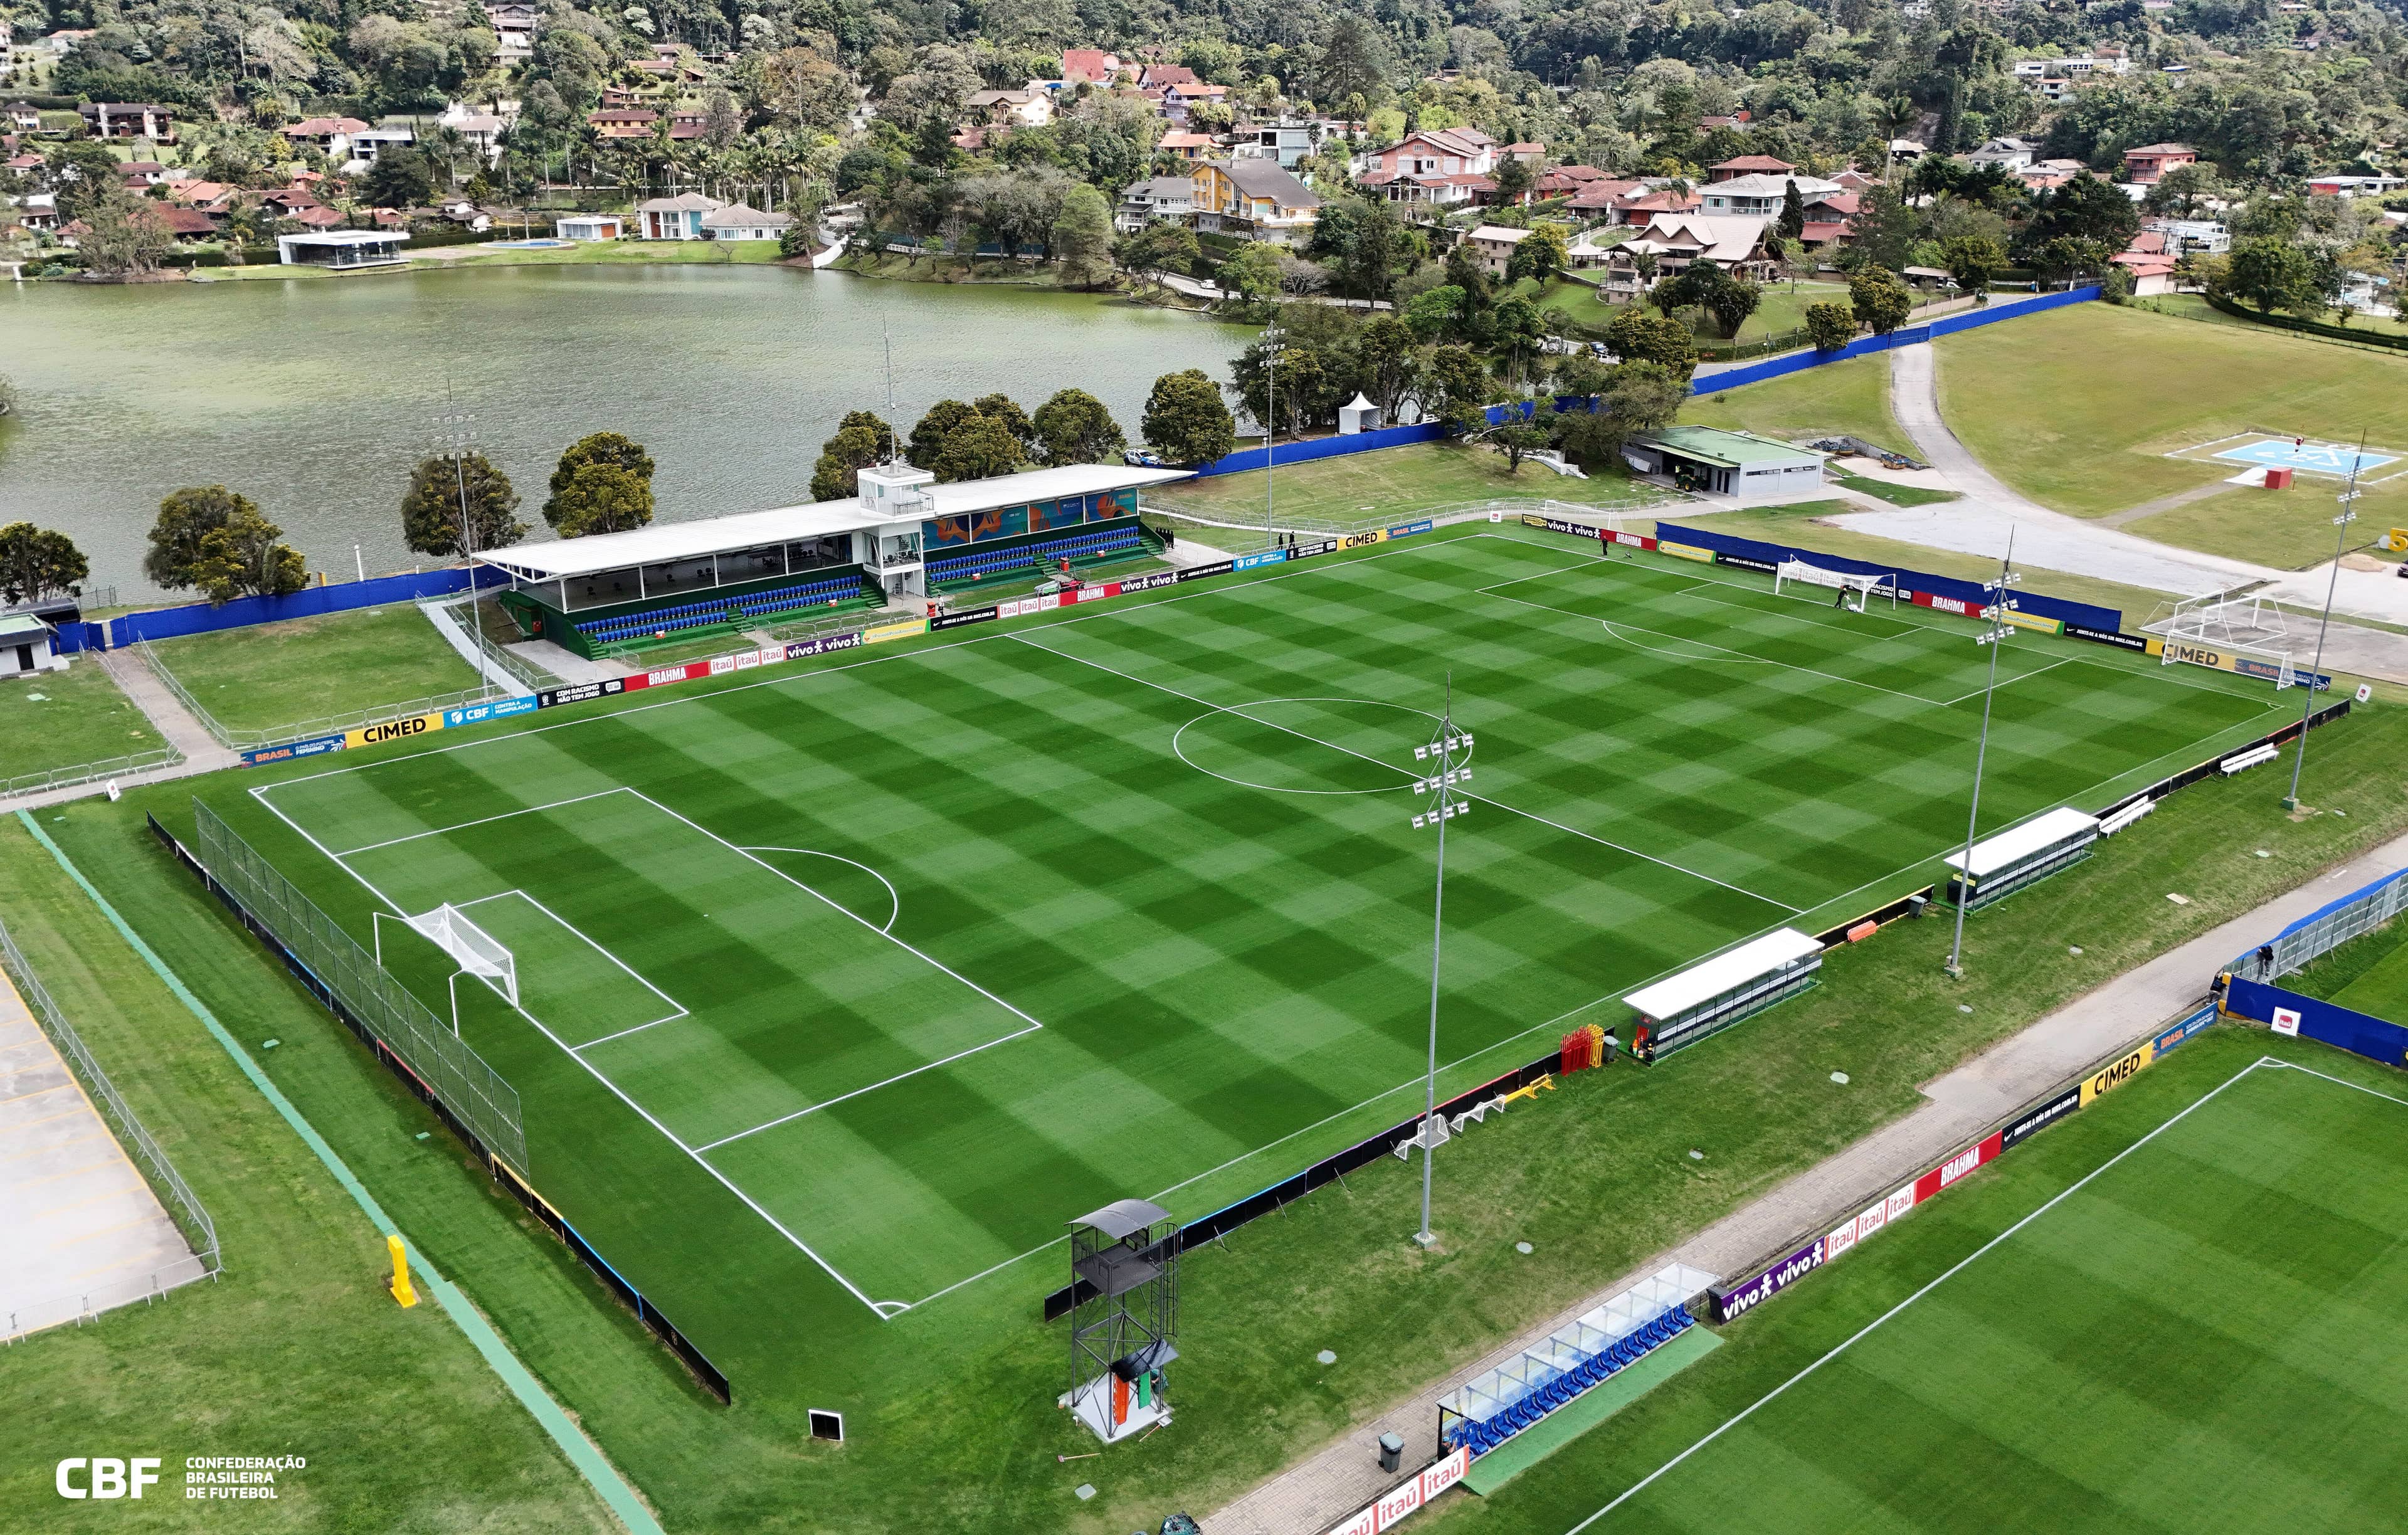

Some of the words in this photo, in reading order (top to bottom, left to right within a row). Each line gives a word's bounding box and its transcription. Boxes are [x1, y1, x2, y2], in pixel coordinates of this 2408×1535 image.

[1393, 527, 1410, 535] BRASIL
[1548, 521, 1566, 531] vivo
[1575, 525, 1593, 536] vivo
[1346, 532, 1378, 547] CIMED
[1616, 533, 1642, 547] BRAHMA
[1245, 557, 1259, 566] CBF
[1121, 581, 1141, 592] vivo
[1151, 576, 1170, 587] vivo
[1874, 583, 1894, 592] ACISMO
[1077, 586, 1104, 602] BRAHMA
[1022, 601, 1037, 612] itaú
[1042, 597, 1057, 608] itaú
[1931, 596, 1965, 614] BRAHMA
[1001, 606, 1017, 616] itaú
[788, 646, 813, 658] vivo
[826, 638, 851, 650] vivo
[2161, 643, 2219, 666] CIMED
[737, 655, 758, 666] itaú
[763, 650, 783, 662] itaú
[712, 660, 732, 670] itaú
[648, 667, 687, 686] BRAHMA
[556, 688, 573, 697] COM
[573, 684, 599, 695] RACISMO
[557, 693, 571, 704] NÃO
[571, 692, 584, 701] TEM
[584, 690, 599, 700] JOGO
[466, 707, 489, 720] CBF
[495, 702, 532, 715] MANIPULAÇÃO
[364, 717, 426, 743] CIMED
[255, 749, 293, 762] BRASIL
[295, 746, 325, 756] FEMININO
[2160, 1028, 2185, 1050] BRASIL
[2094, 1052, 2140, 1095] CIMED
[2032, 1118, 2036, 1126] A
[1941, 1146, 1979, 1188] BRAHMA
[1889, 1189, 1912, 1216] itaú
[1860, 1208, 1883, 1235] itaú
[1830, 1226, 1854, 1253] itaú
[1777, 1257, 1811, 1287] vivo
[1723, 1288, 1757, 1321] vivo
[1427, 1457, 1461, 1494] itaú
[1381, 1486, 1417, 1524] itaú
